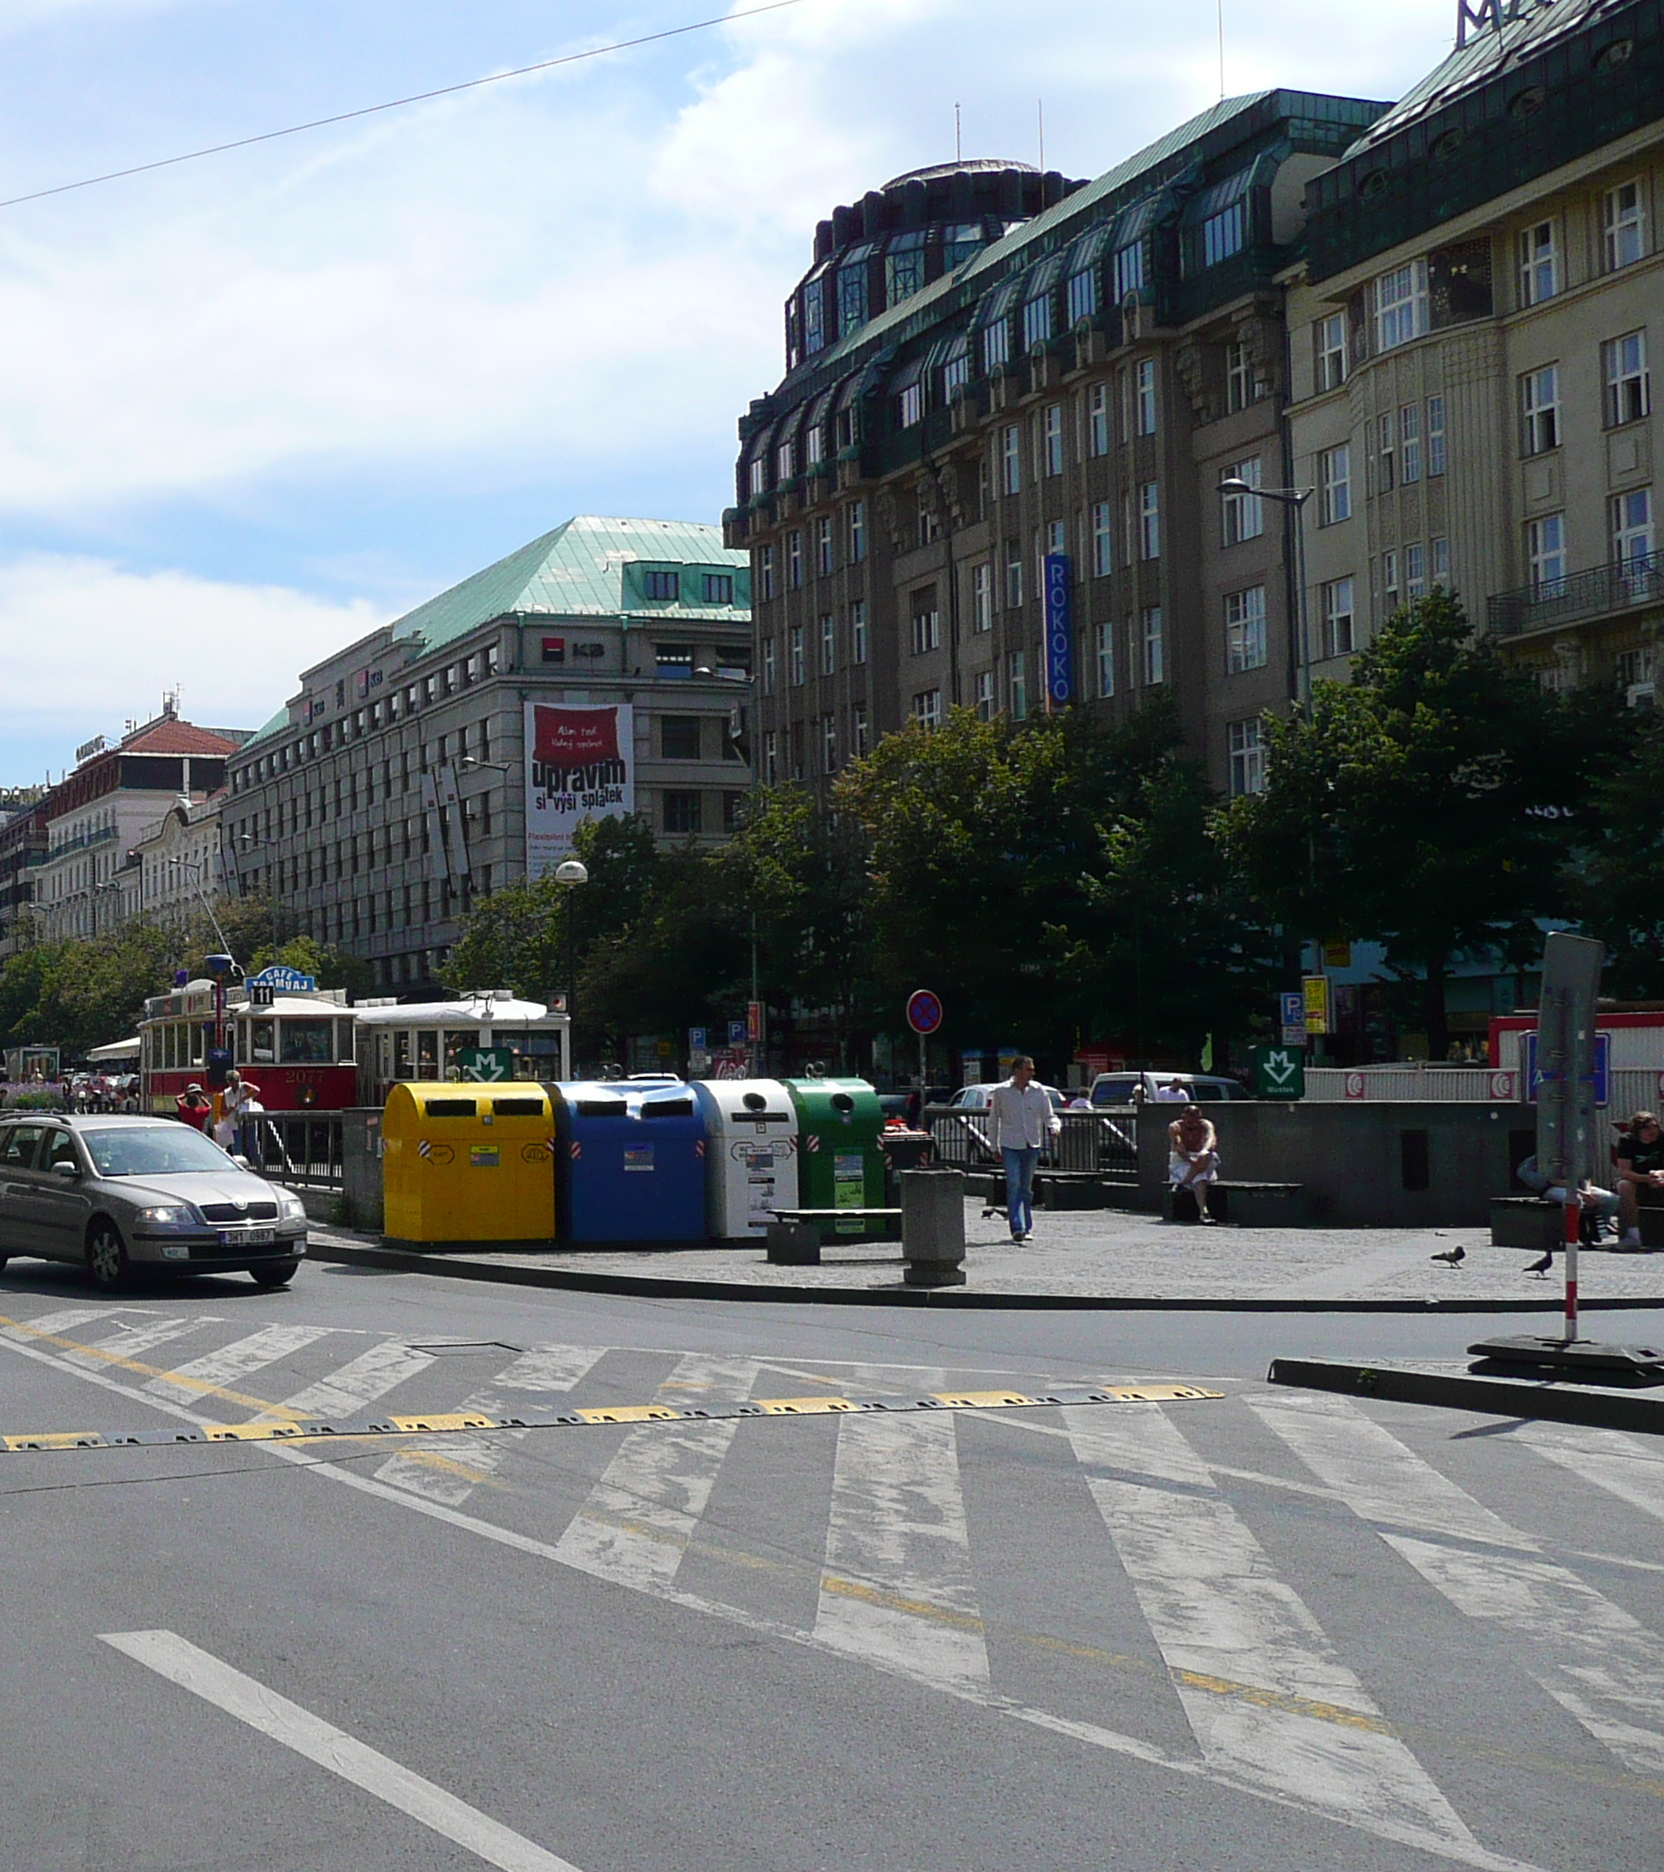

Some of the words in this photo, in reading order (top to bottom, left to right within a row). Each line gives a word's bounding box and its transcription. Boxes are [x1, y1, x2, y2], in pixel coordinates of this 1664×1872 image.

[1051, 564, 1069, 700] ROKOKO
[572, 643, 605, 658] KB
[536, 792, 546, 810] si
[581, 787, 623, 810] splátek
[258, 988, 270, 1003] 11
[286, 1070, 325, 1083] 2077
